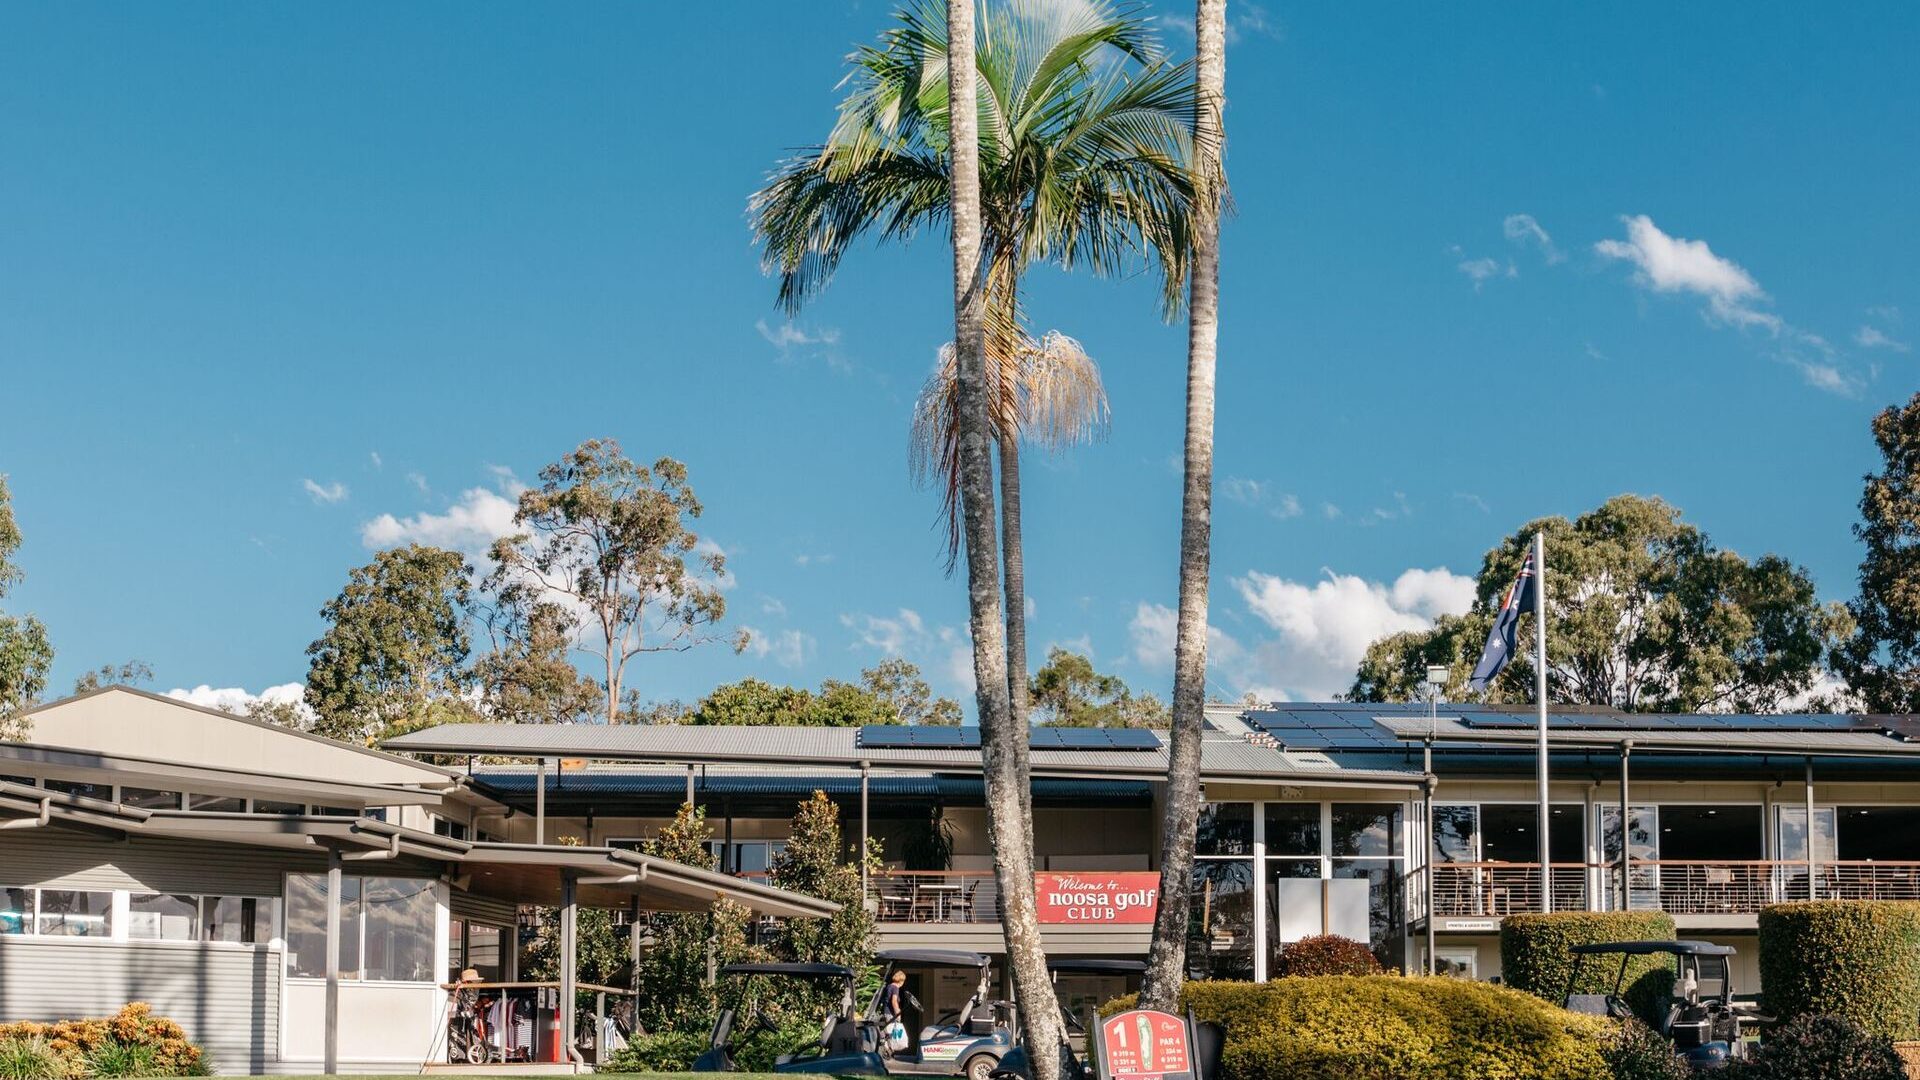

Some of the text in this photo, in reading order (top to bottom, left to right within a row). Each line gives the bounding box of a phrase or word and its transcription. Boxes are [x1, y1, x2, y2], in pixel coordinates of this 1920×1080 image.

[1057, 877, 1104, 891] Welcome
[1048, 889, 1156, 911] noosa golf
[1067, 908, 1116, 919] CLUB
[1113, 1021, 1127, 1048] 1
[1159, 1038, 1174, 1046] PAR
